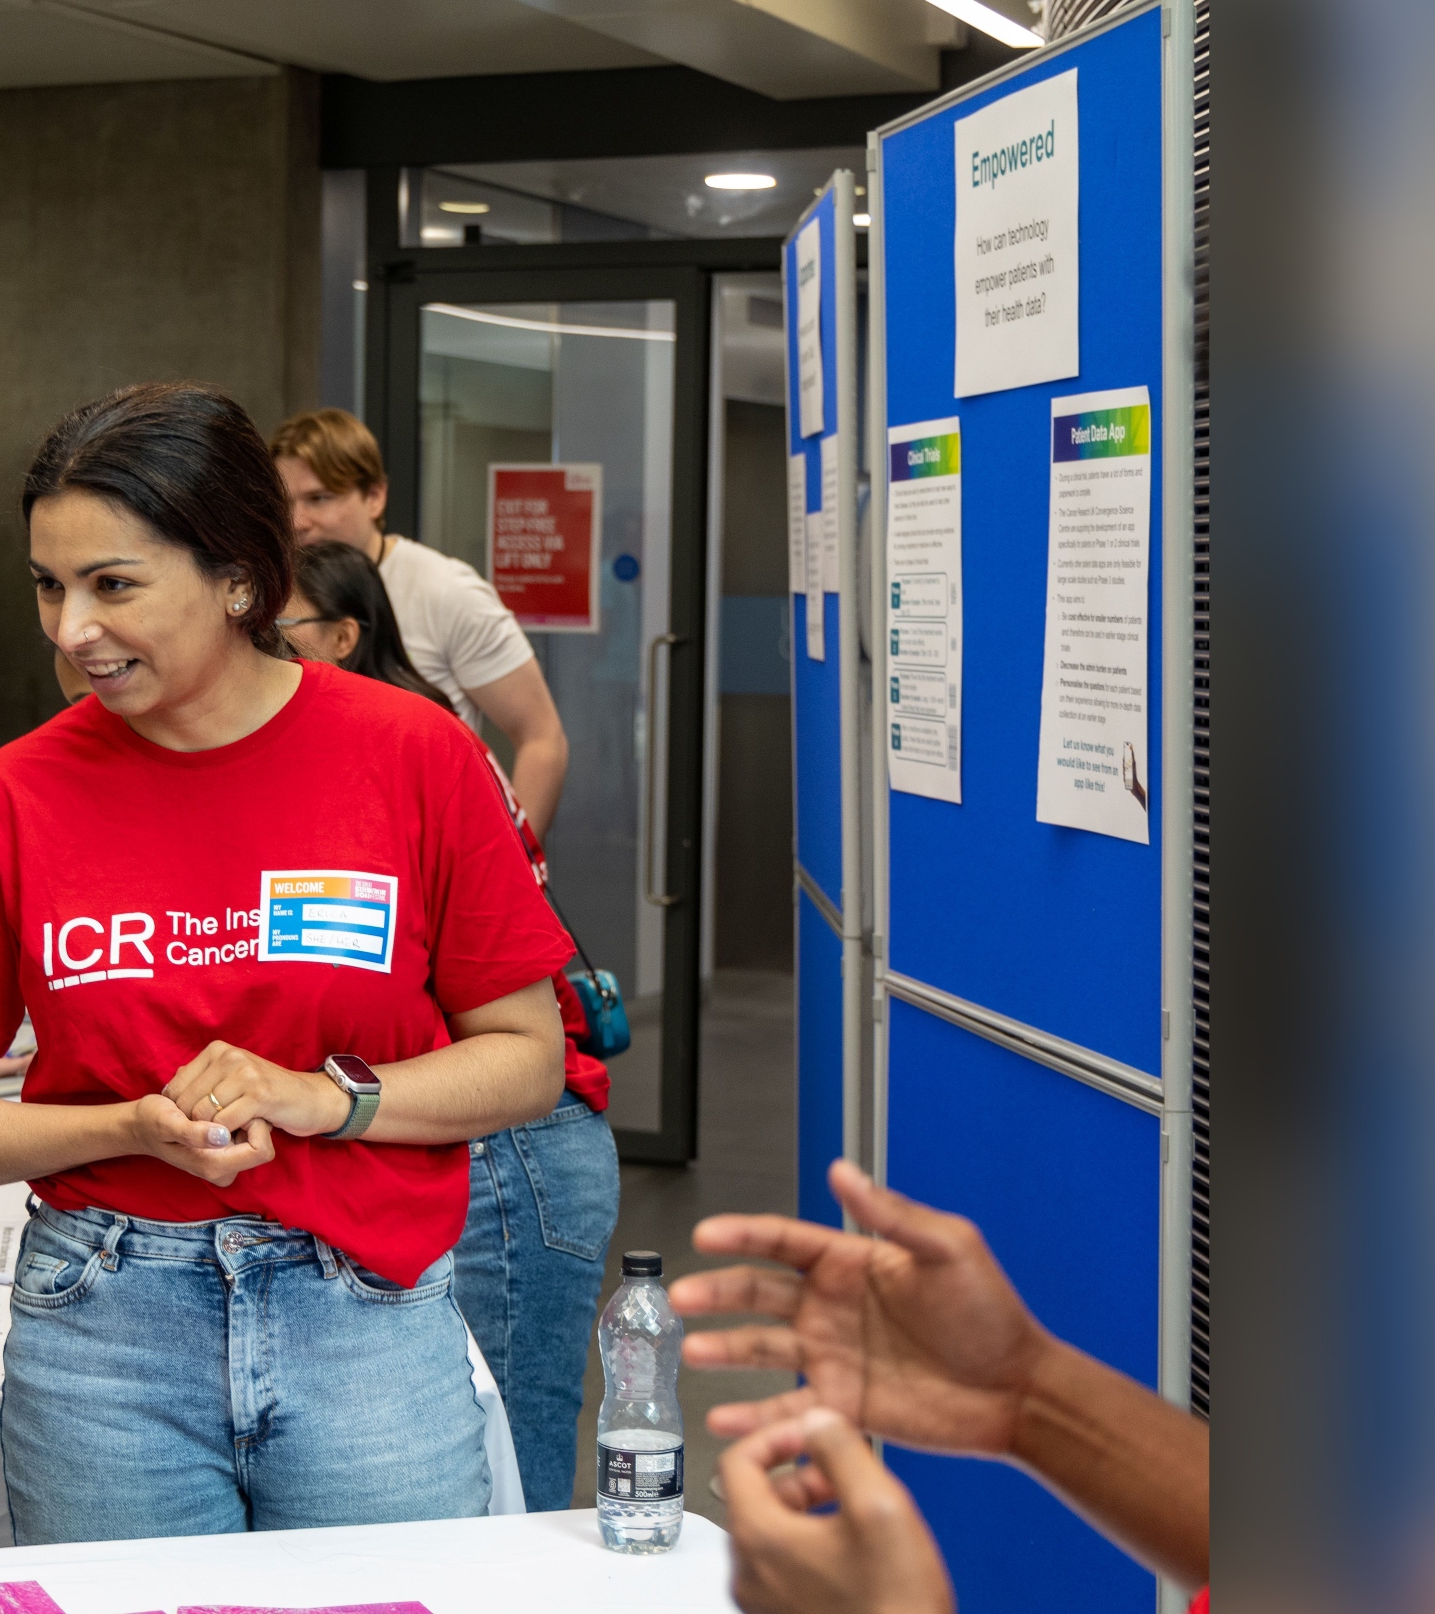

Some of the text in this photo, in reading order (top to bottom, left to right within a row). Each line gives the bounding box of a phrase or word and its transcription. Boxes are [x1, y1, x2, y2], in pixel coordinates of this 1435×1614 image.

[972, 119, 1055, 188] Empowered
[976, 217, 1049, 257] How can technology
[974, 254, 1055, 296] empower patients with
[984, 292, 1046, 328] their health data?
[1071, 422, 1126, 445] Patient Data App
[908, 447, 940, 466] Clinical Trials
[1063, 736, 1114, 758] Let us know what you
[1057, 756, 1118, 776] would like to see from an
[1074, 778, 1105, 793] app like this!
[274, 881, 324, 894] WELCOME
[166, 910, 218, 936] The
[43, 911, 155, 976] ICR
[166, 938, 260, 966] Cancer
